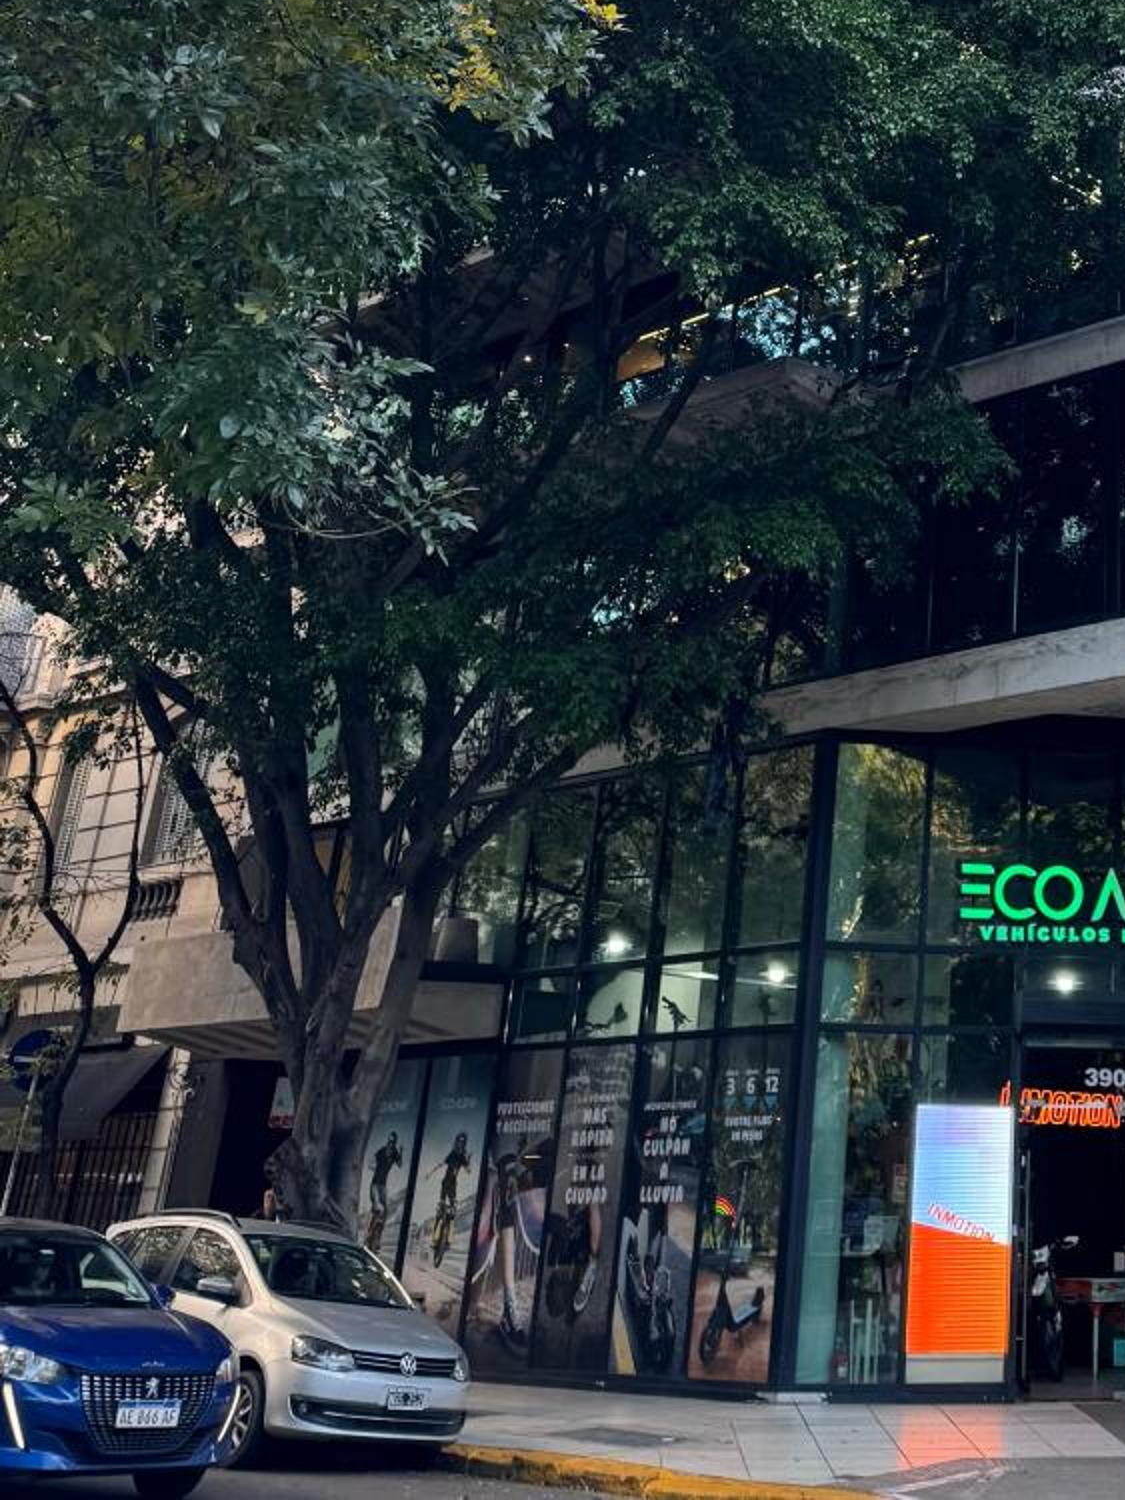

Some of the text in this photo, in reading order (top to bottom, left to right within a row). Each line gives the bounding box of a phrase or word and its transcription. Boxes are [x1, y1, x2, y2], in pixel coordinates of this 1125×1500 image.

[960, 863, 1084, 921] ECO
[979, 924, 1110, 943] VEHÍCULOS
[724, 1076, 779, 1095] 3 6 12
[639, 1186, 684, 1203] LLUVIA
